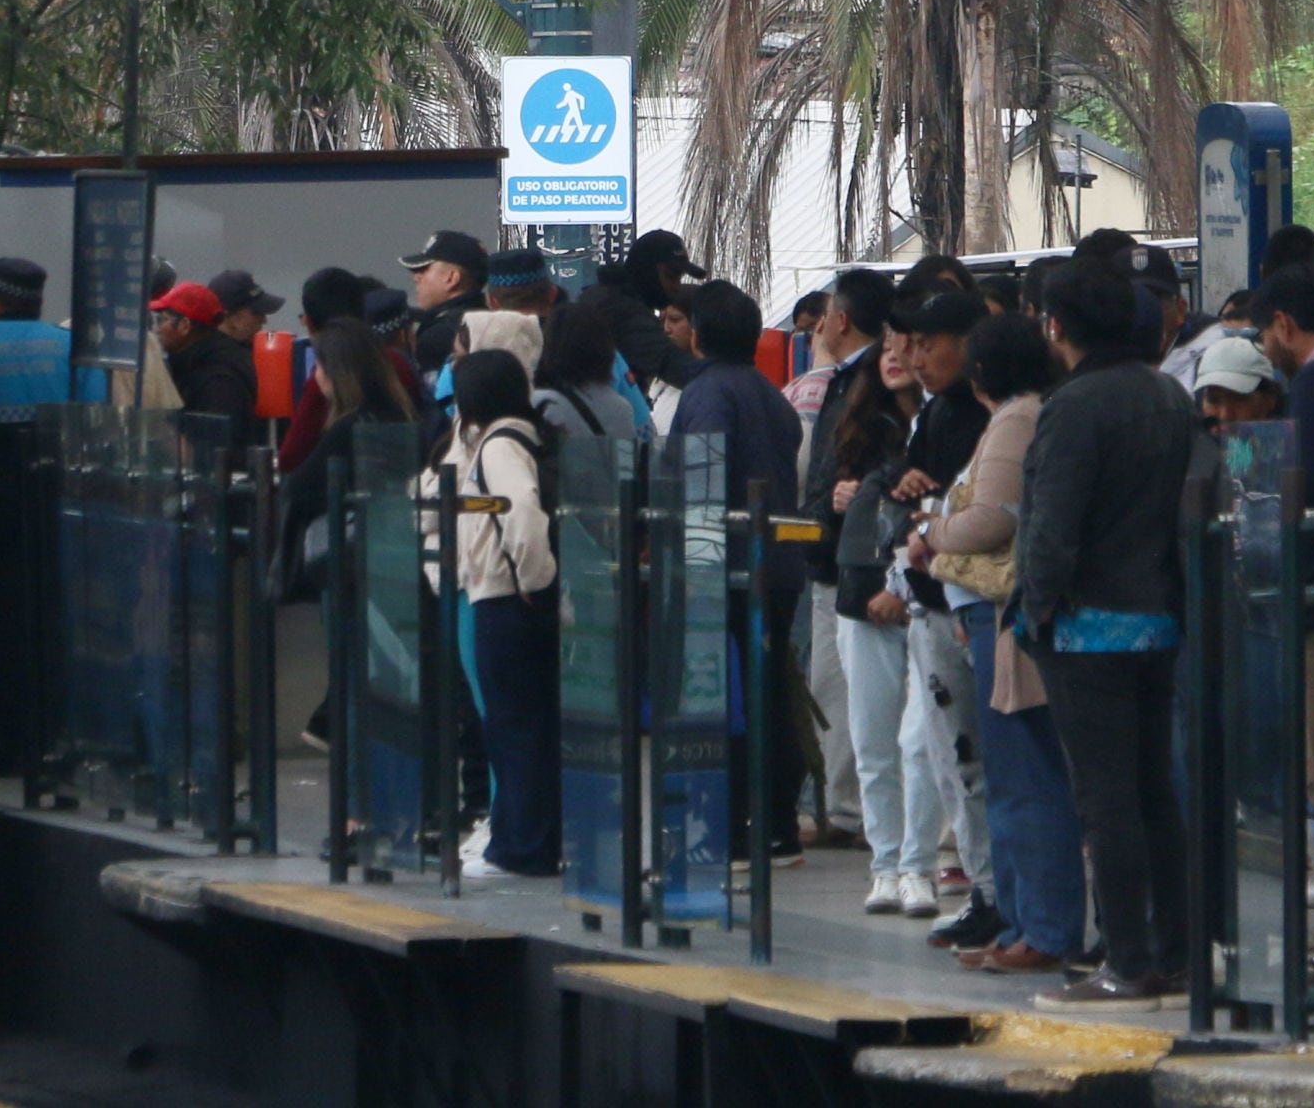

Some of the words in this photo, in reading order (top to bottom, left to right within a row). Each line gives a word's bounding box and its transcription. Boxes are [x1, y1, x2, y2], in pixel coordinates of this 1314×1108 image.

[517, 181, 540, 192] USO
[543, 180, 618, 192] OBLIGATORIO
[512, 195, 528, 205] DE
[531, 195, 562, 205] PASO
[564, 194, 623, 205] PEATONAL
